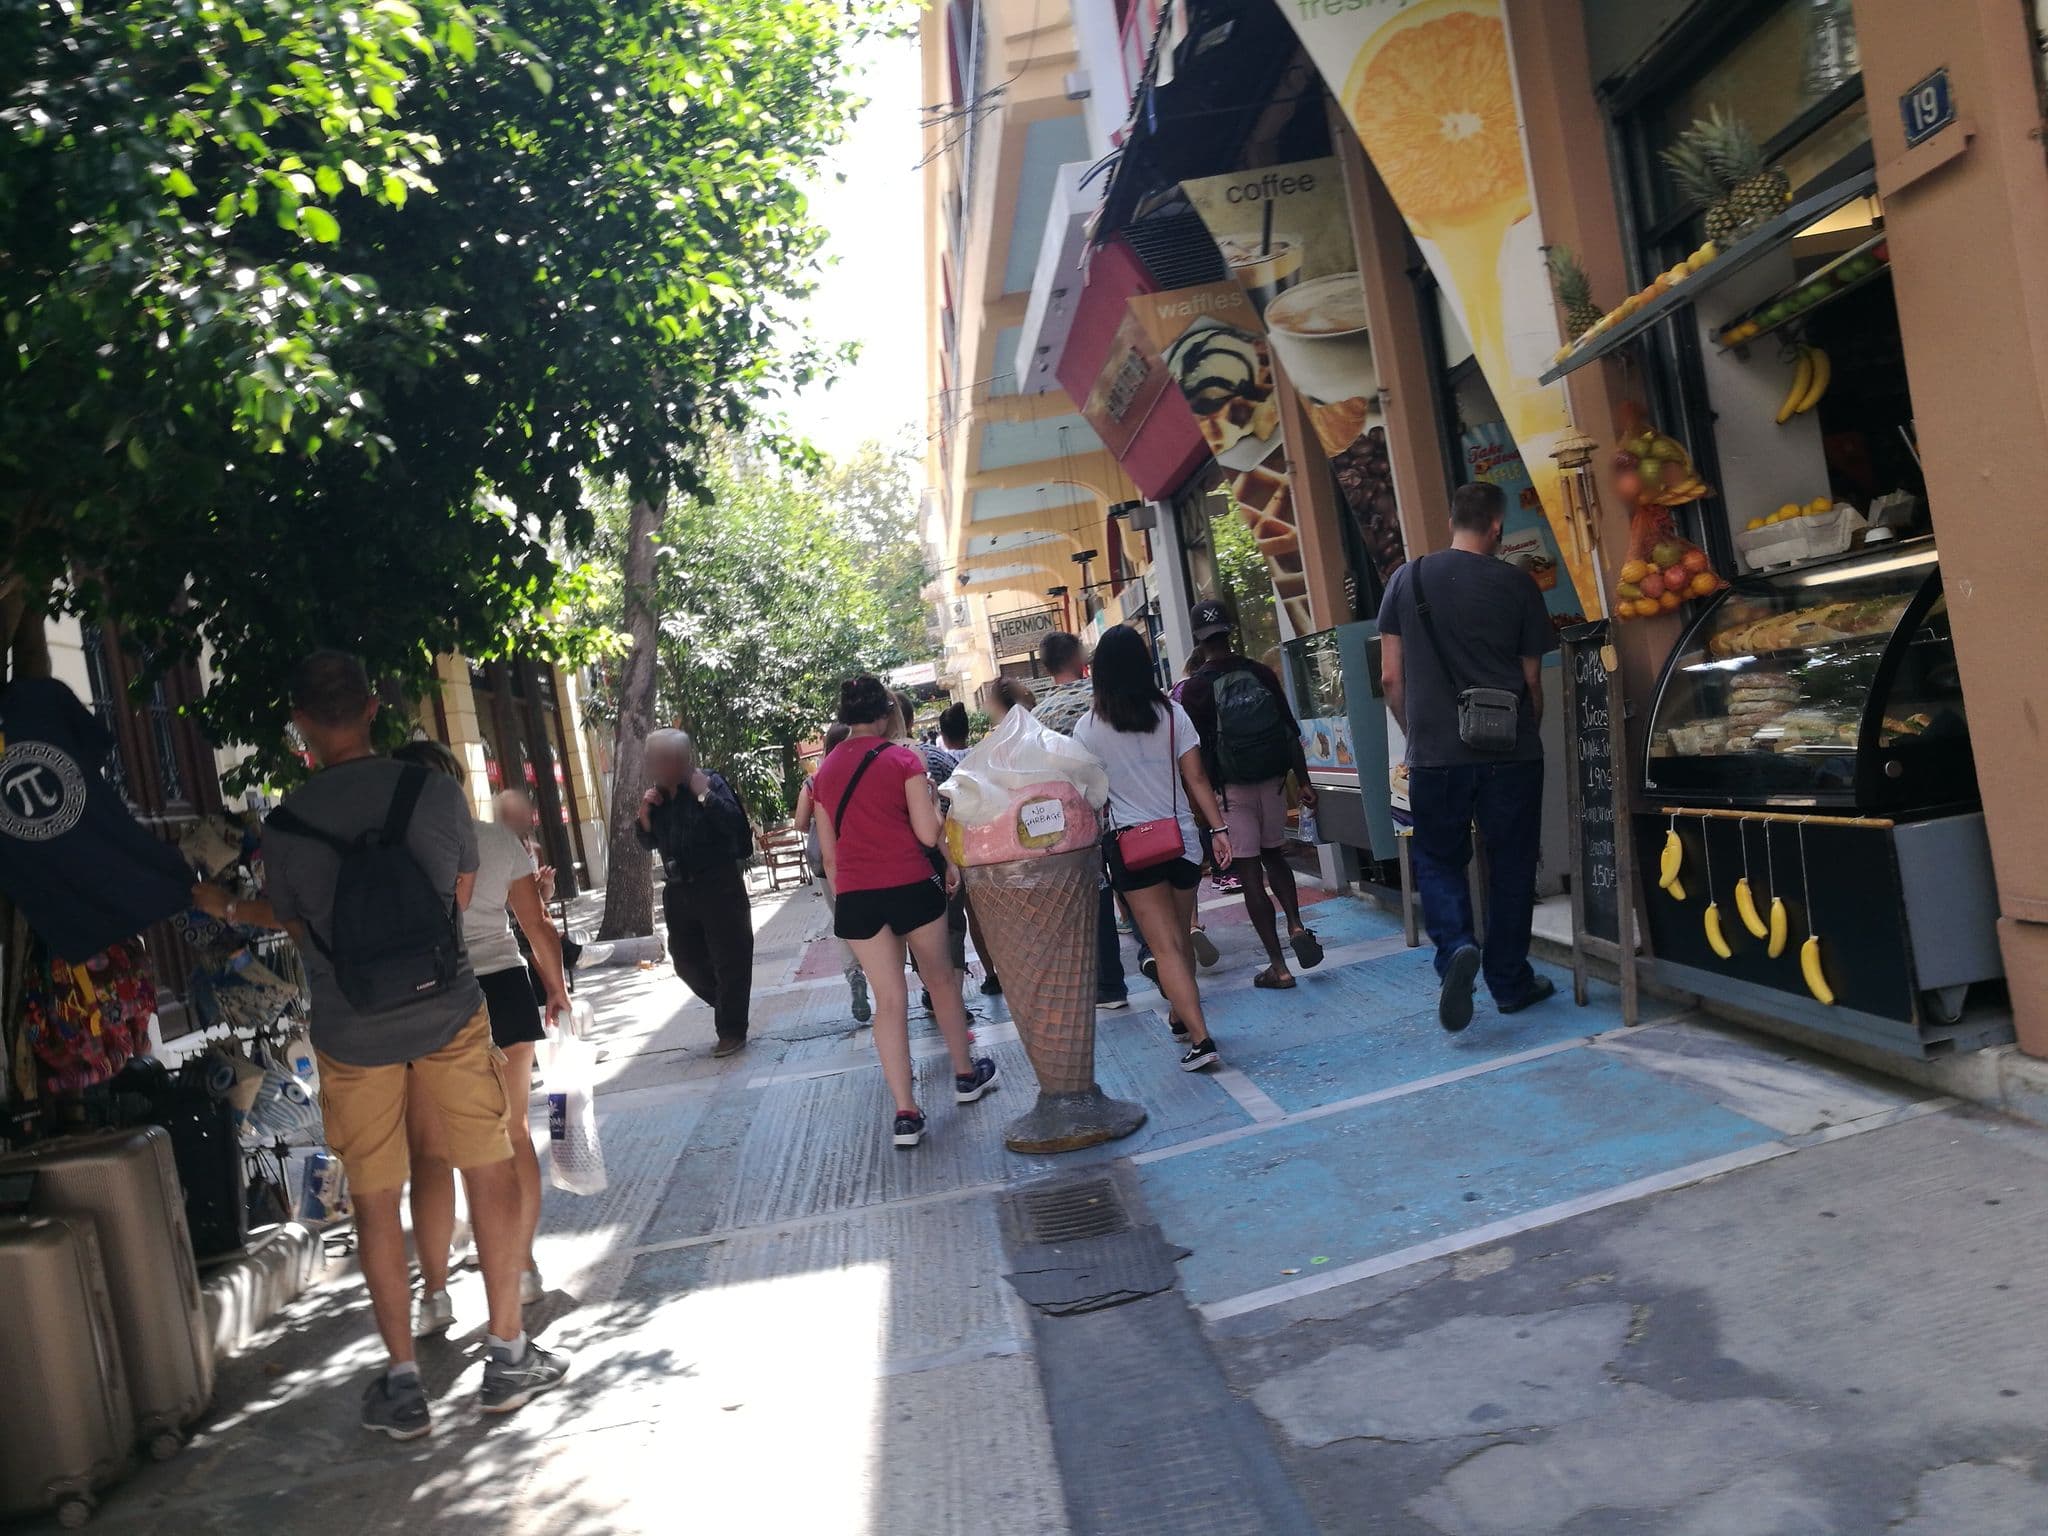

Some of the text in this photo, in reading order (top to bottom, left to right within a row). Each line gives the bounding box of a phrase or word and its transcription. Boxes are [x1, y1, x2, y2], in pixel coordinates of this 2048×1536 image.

[1913, 86, 1938, 130] 19
[1226, 173, 1315, 204] coffee
[1157, 291, 1243, 319] waffles
[1000, 613, 1053, 638] HERMION
[1025, 812, 1061, 826] GARBAGE
[1032, 806, 1045, 815] NO
